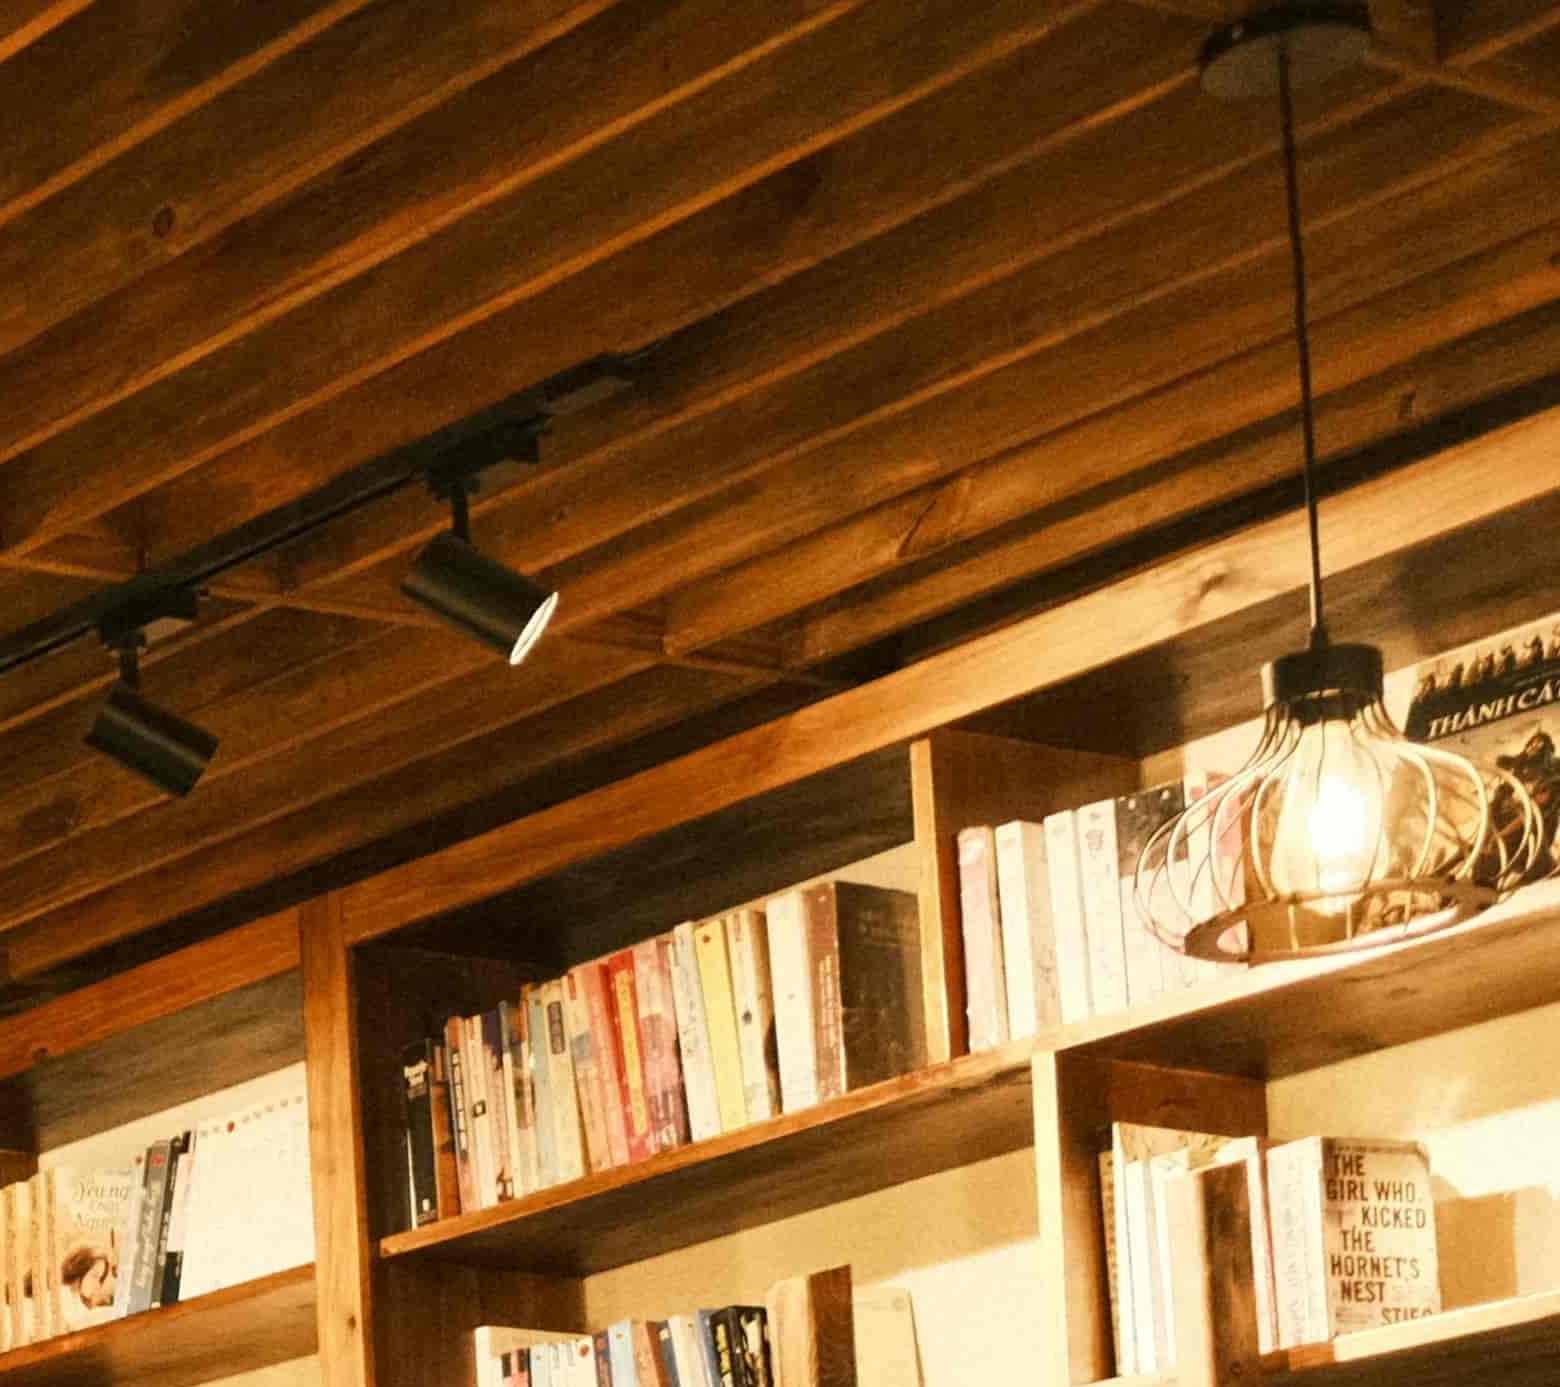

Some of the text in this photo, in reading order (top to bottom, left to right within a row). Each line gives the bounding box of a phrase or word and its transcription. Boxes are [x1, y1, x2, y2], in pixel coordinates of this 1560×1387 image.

[1333, 1153, 1367, 1177] THE
[1326, 1178, 1417, 1204] GIRL WHO
[1361, 1206, 1427, 1230] KICKED
[1340, 1225, 1377, 1253] THE
[1331, 1254, 1421, 1280] HORNET'S
[1340, 1279, 1386, 1305] NEST
